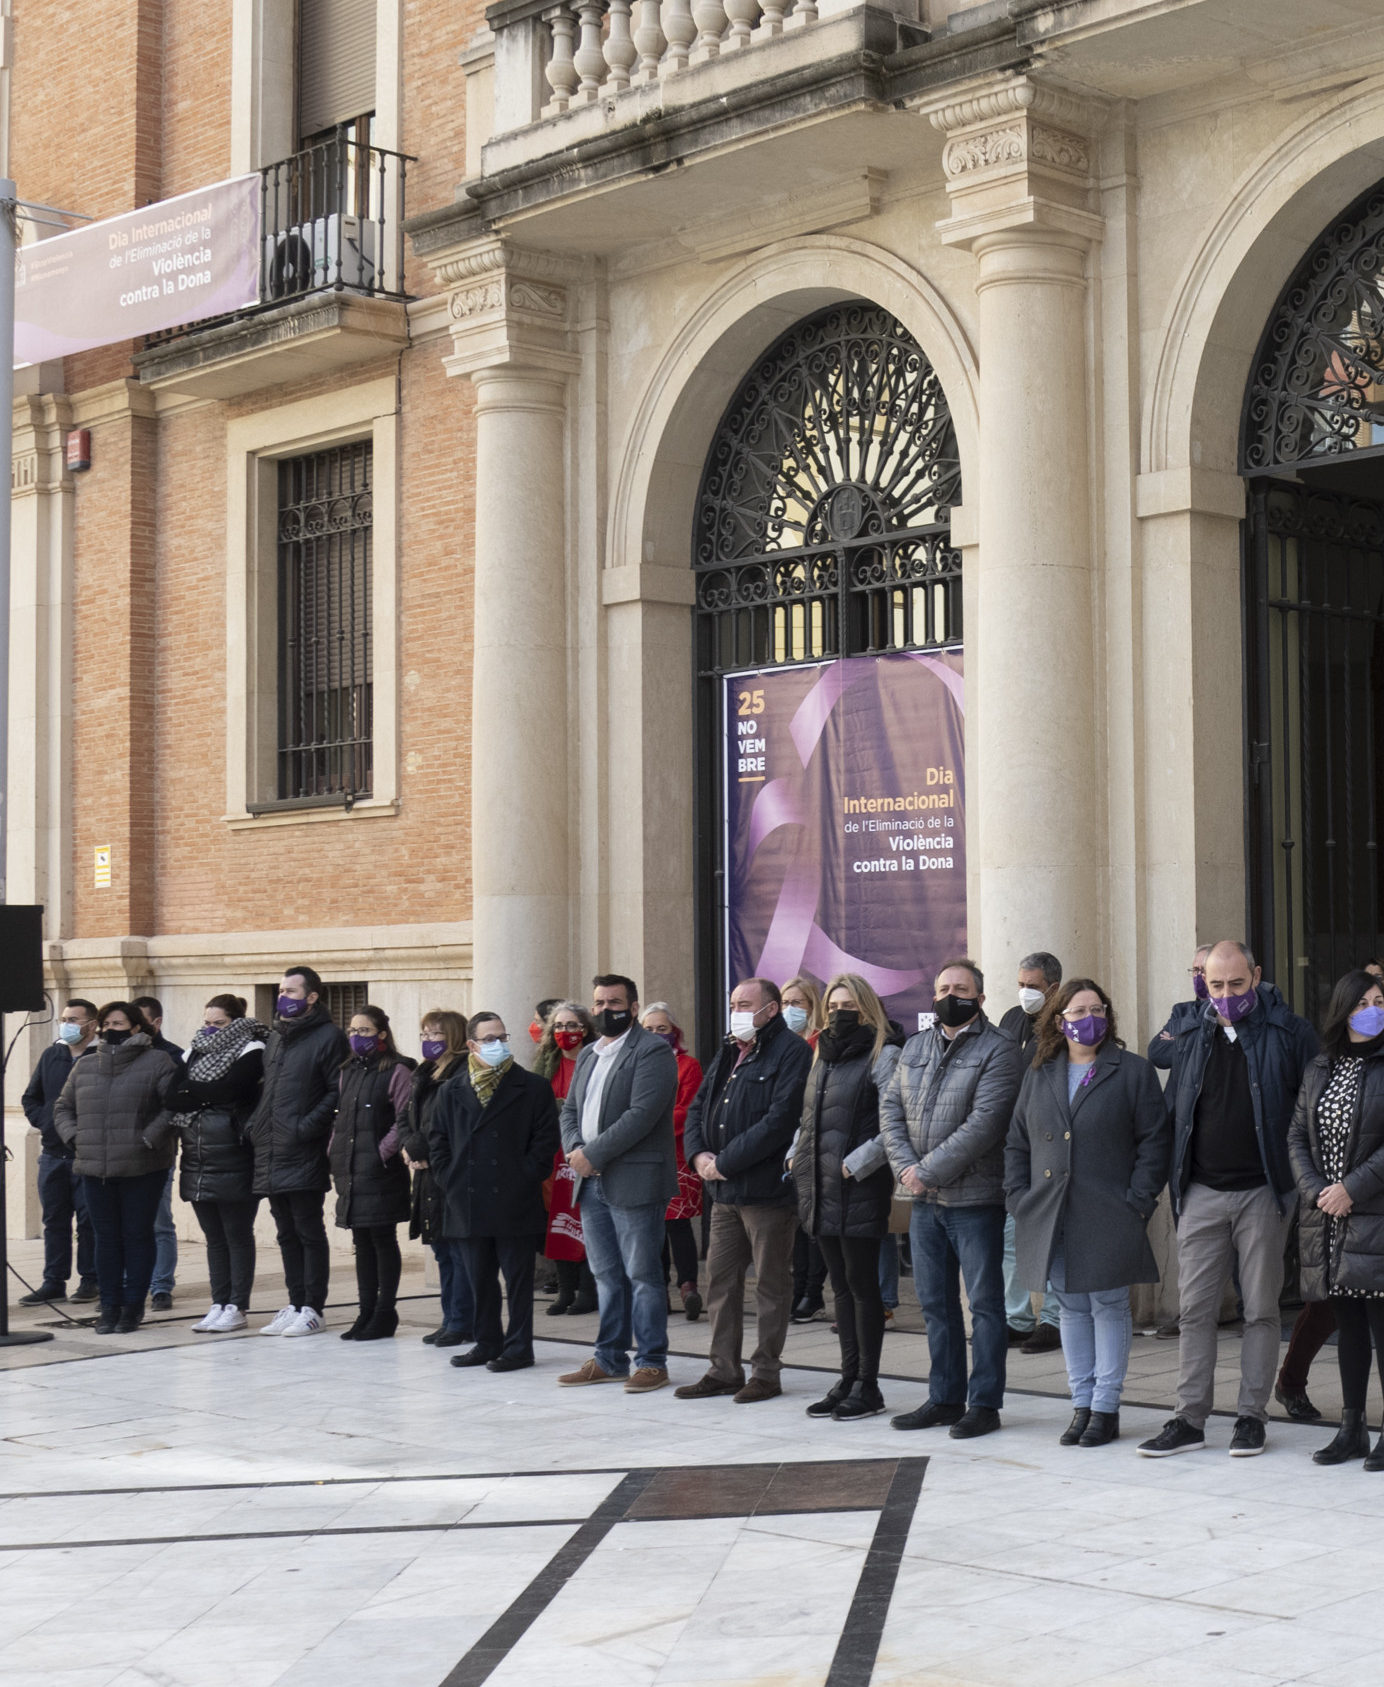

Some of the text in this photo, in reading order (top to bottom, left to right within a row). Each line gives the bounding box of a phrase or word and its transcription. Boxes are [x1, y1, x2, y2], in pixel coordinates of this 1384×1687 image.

[108, 203, 212, 250] Dia Internacional
[109, 254, 122, 269] de
[185, 230, 199, 245] de
[201, 226, 211, 240] la
[152, 246, 212, 276] Violència
[120, 270, 211, 307] contra la Dona
[738, 689, 765, 716] 25
[737, 720, 757, 735] NO
[737, 738, 766, 754] VEM
[738, 757, 766, 772] BRE
[926, 766, 954, 785] Dia
[843, 789, 954, 814] Internacional
[844, 821, 859, 833] de
[927, 816, 941, 828] de
[944, 815, 954, 828] la
[889, 833, 954, 851] Violència
[853, 855, 954, 873] contra la Dona
